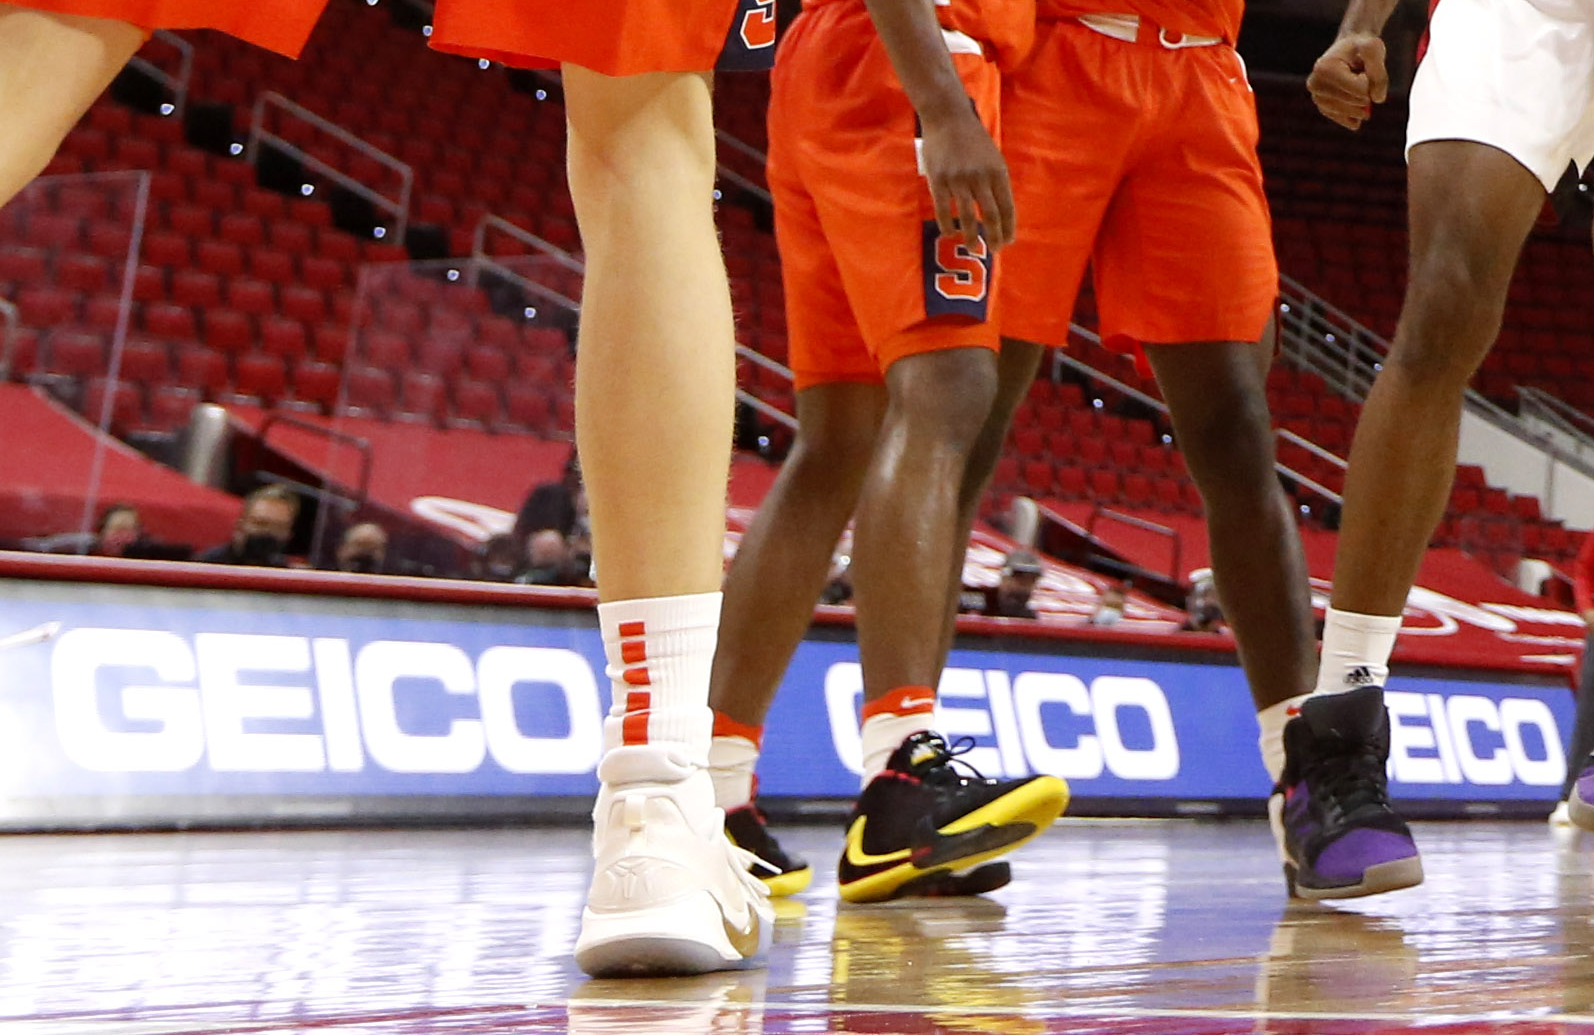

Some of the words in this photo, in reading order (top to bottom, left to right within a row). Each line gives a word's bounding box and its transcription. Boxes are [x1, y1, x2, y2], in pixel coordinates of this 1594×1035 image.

[934, 231, 989, 304] S
[51, 626, 603, 775] GEICO
[1383, 690, 1568, 786] EICO
